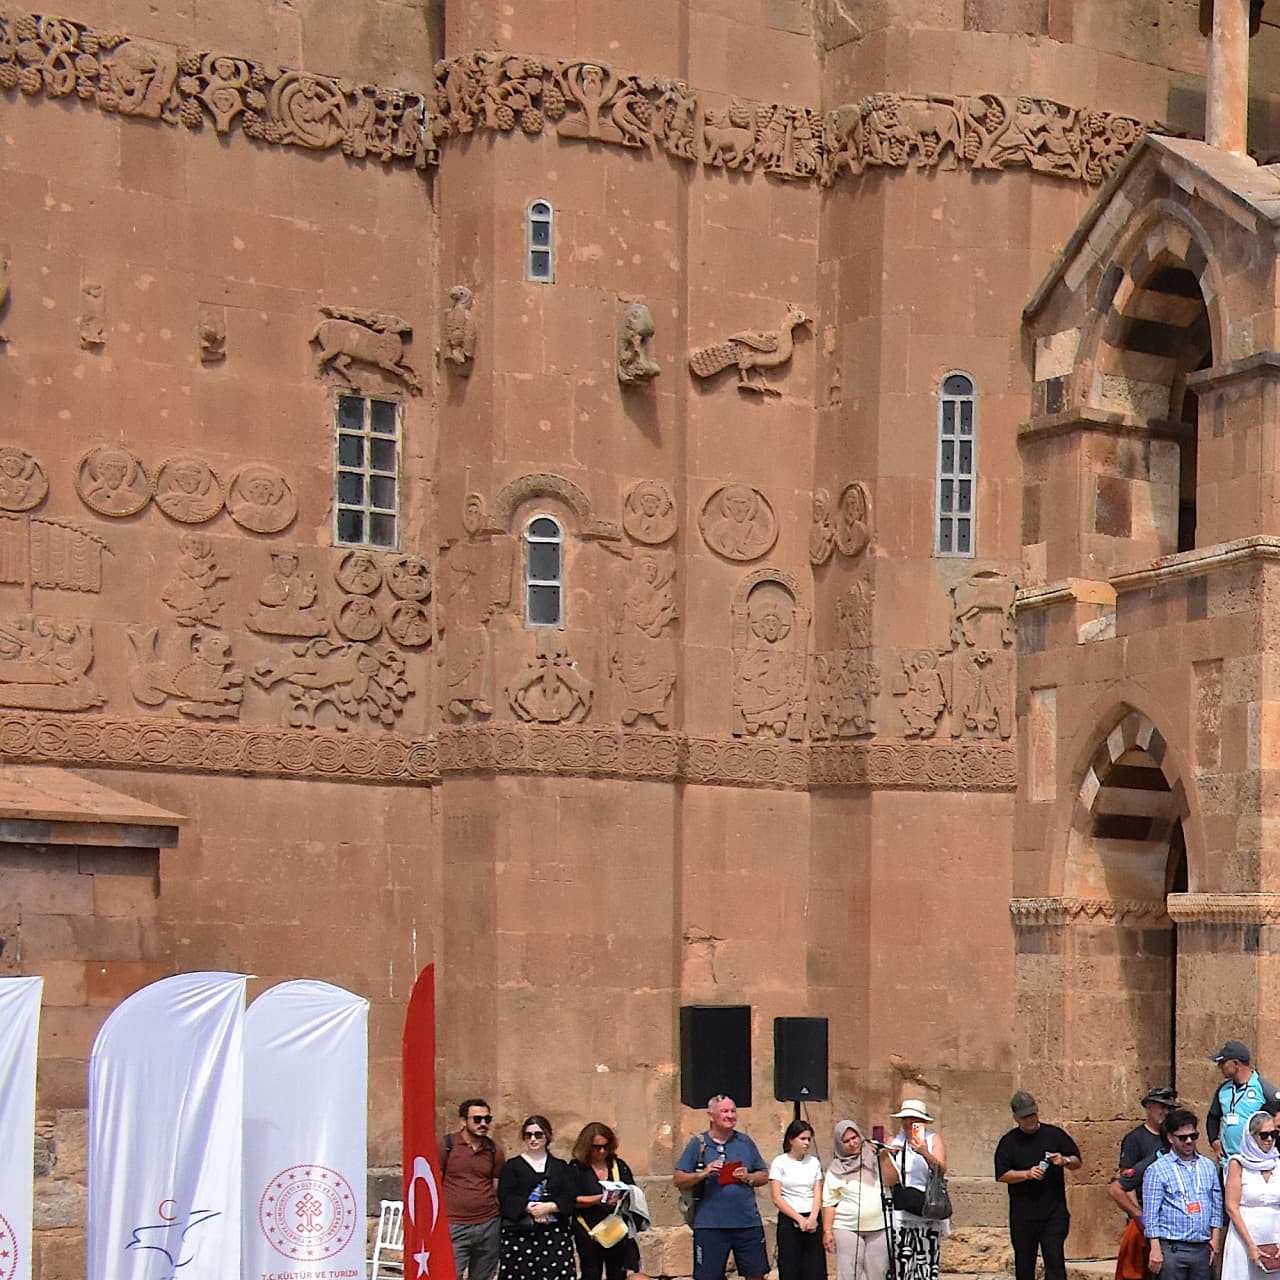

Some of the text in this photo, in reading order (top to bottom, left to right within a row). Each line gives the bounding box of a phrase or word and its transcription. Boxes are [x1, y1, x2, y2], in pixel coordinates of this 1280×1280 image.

[277, 1270, 312, 1280] KÜLTÜR
[315, 1271, 327, 1279] VE
[329, 1269, 359, 1279] TURİZM
